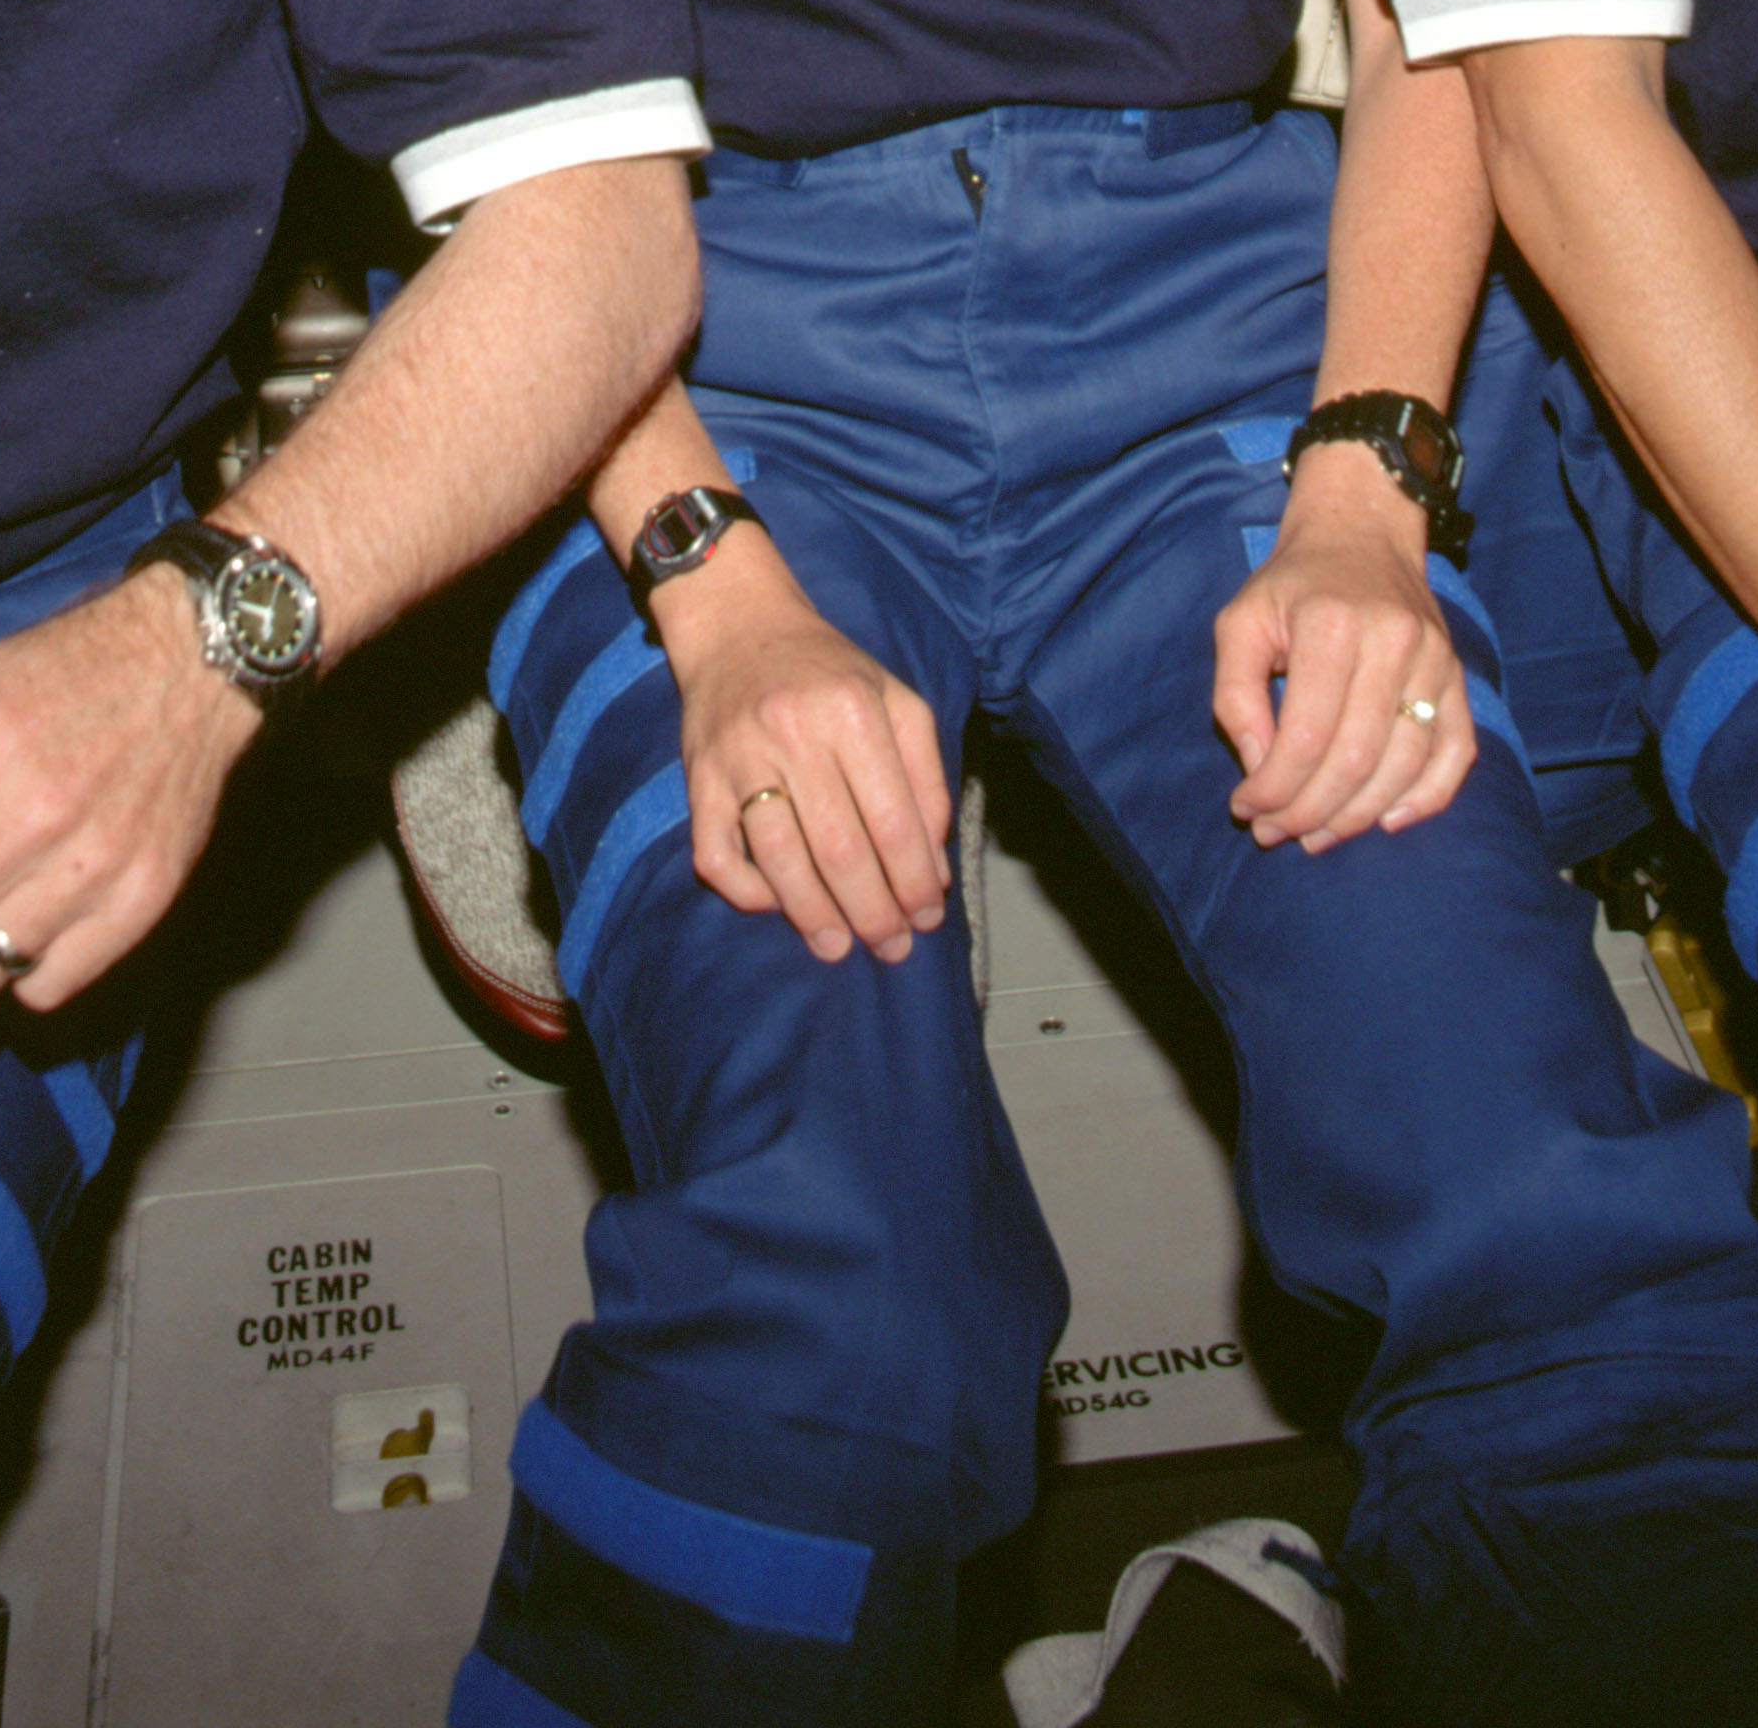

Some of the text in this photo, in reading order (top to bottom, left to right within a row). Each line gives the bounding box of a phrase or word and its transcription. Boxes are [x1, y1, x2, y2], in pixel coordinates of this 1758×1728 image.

[266, 1237, 374, 1274] CABIN
[271, 1273, 371, 1309] TEMP
[237, 1303, 406, 1348] CONTROL
[266, 1342, 376, 1371] MD44F
